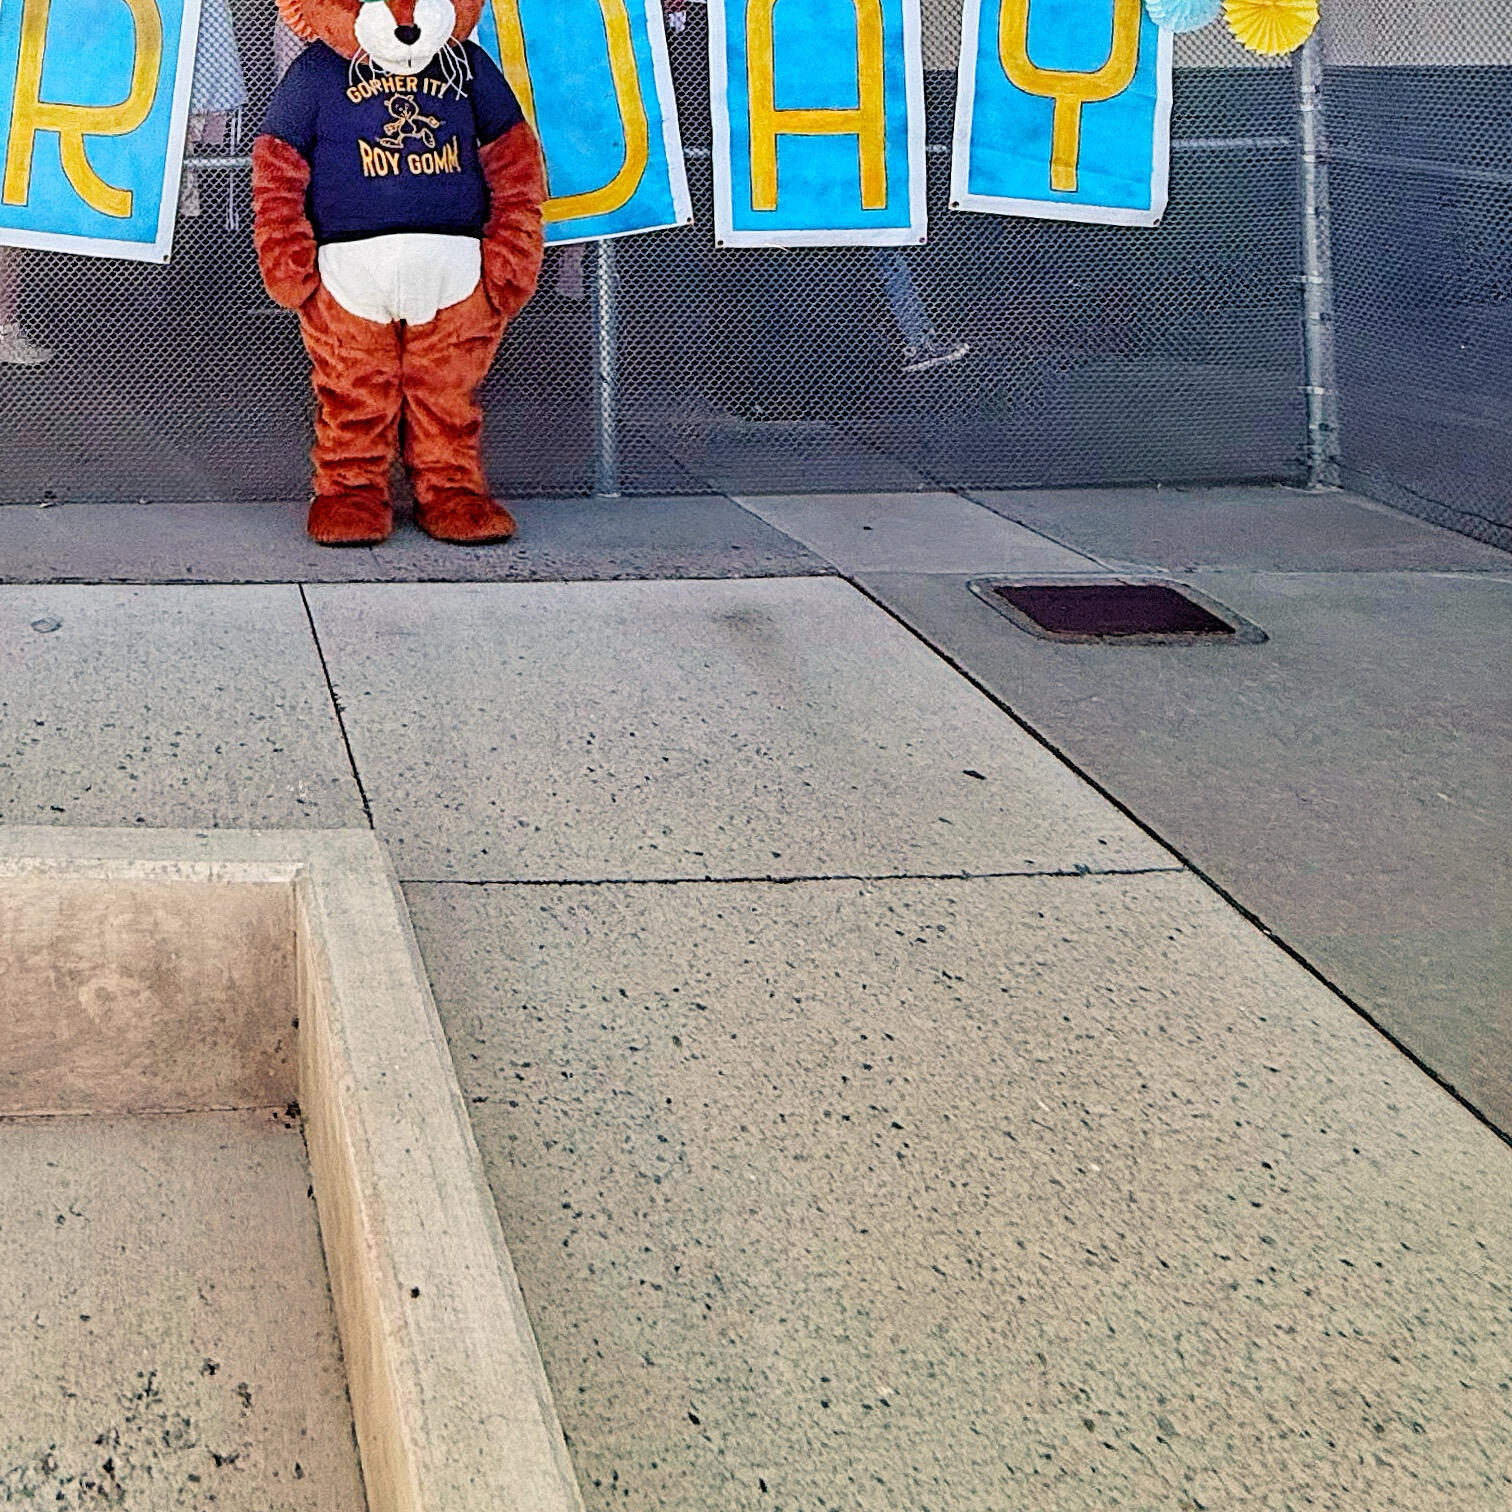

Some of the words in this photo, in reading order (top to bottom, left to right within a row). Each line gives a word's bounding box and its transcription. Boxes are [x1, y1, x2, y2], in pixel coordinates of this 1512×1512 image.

[346, 76, 418, 103] GOPHER
[358, 139, 400, 177] ROY
[407, 136, 462, 175] GOMM
